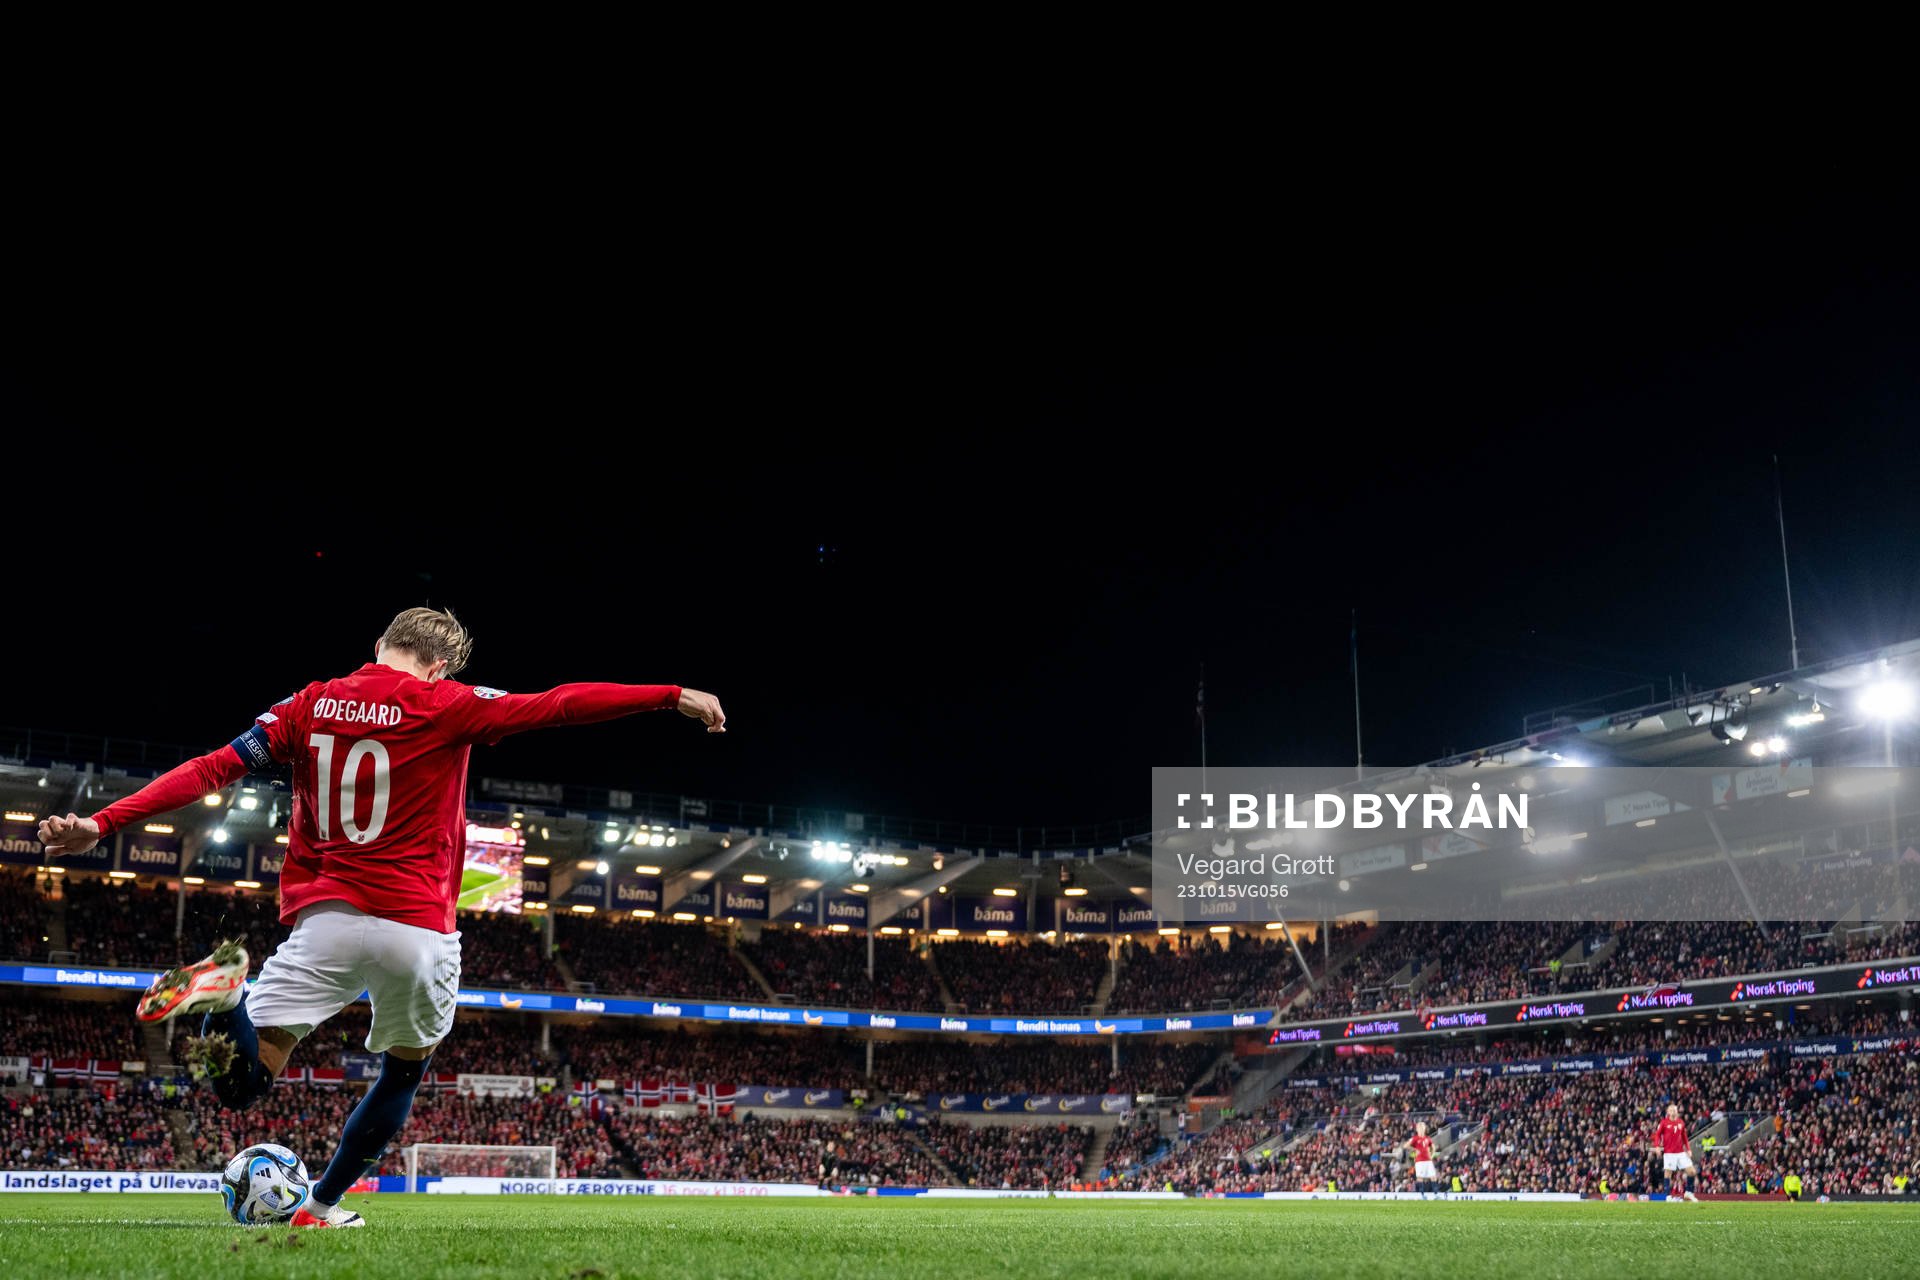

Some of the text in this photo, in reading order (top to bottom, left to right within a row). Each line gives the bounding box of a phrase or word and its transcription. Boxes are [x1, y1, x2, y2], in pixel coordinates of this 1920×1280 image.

[313, 697, 402, 726] ØDEGAARD
[309, 733, 391, 844] 10
[129, 845, 178, 865] bama
[204, 854, 243, 870] ama
[618, 883, 658, 902] bama
[726, 892, 765, 910] bama
[828, 901, 865, 918] bama
[974, 906, 1014, 922] bama
[1066, 908, 1106, 923] bama
[1118, 907, 1152, 922] bama
[56, 970, 136, 986] Bendit banan
[1875, 968, 1908, 985] Norsk
[1746, 978, 1815, 997] Norsk Tipping
[1529, 1002, 1584, 1018] Norsk Tipping
[1016, 1020, 1081, 1033] Bendit banan
[1166, 1018, 1192, 1031] bama
[1233, 1014, 1255, 1026] bama
[1437, 1011, 1488, 1027] Norsk Tipping
[1354, 1021, 1400, 1034] Norsk Tipping
[5, 1171, 220, 1193] landslaget på Ullevaa
